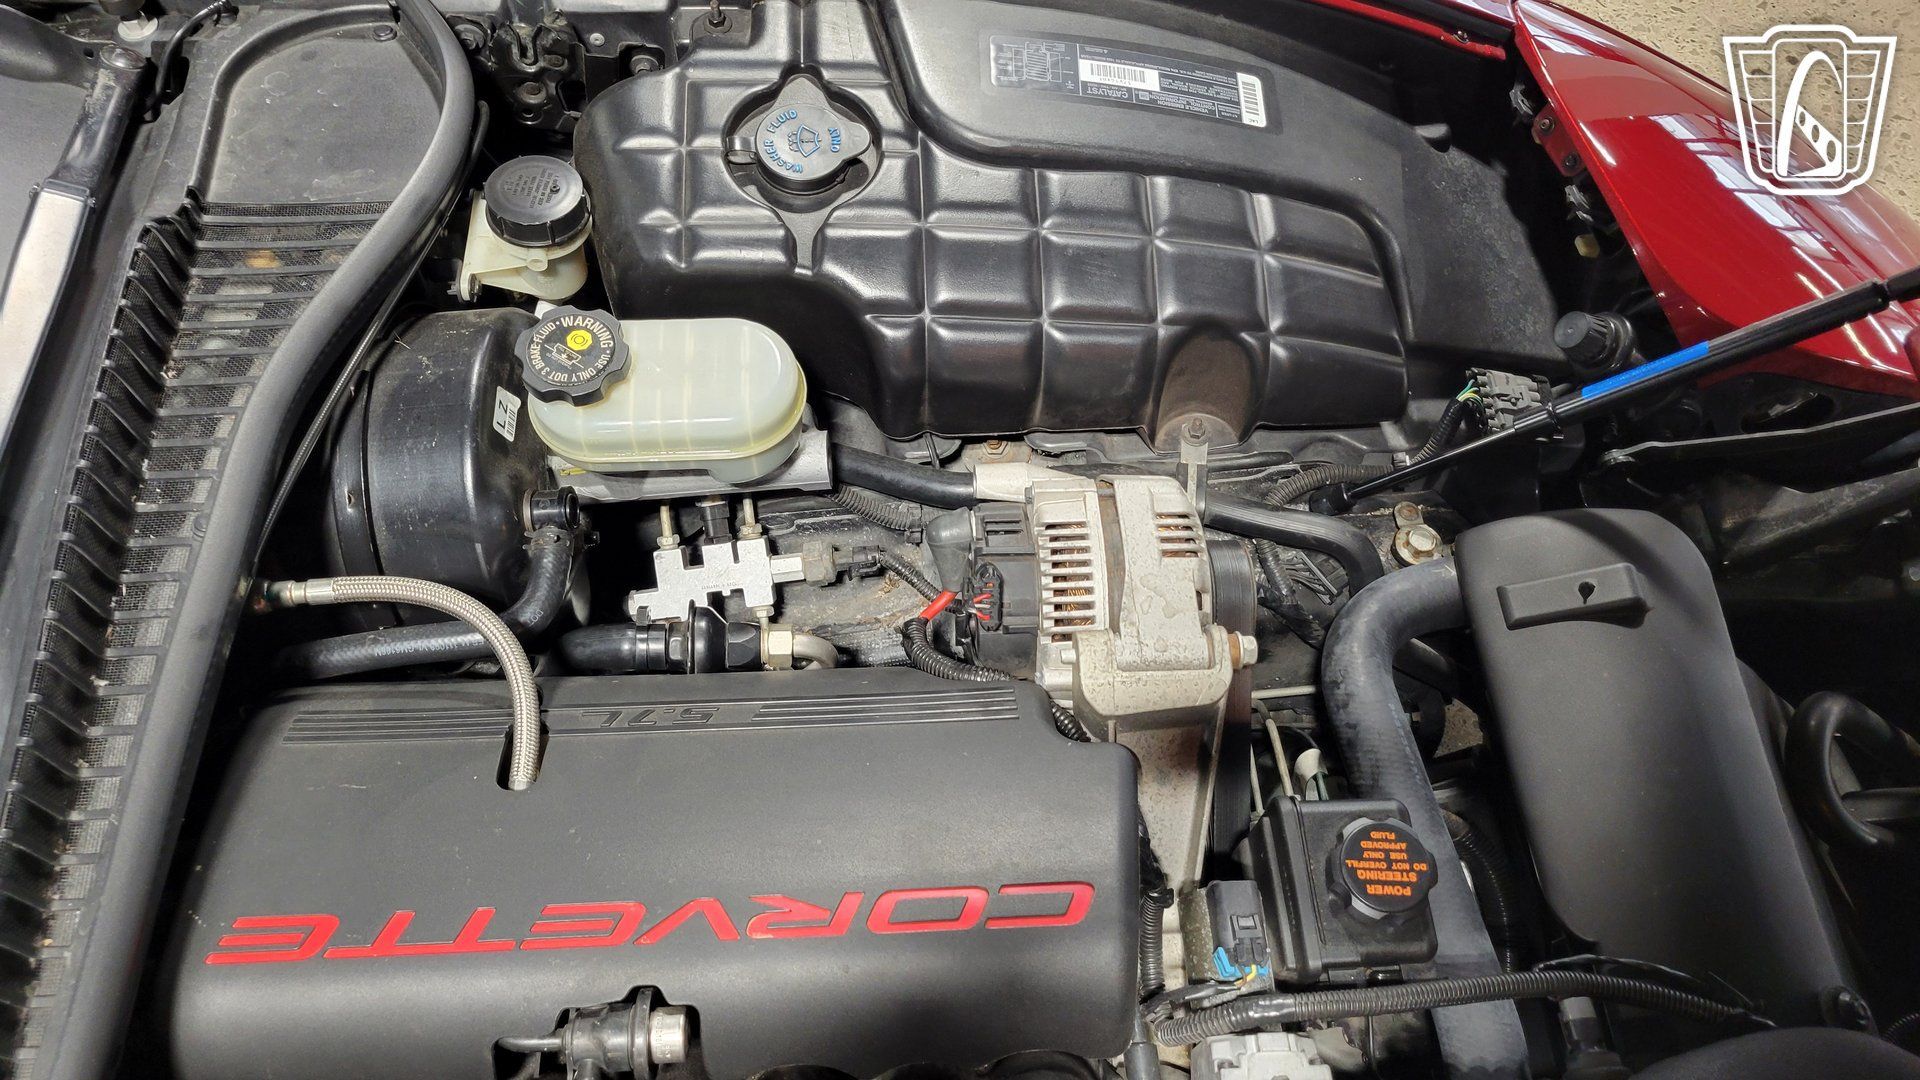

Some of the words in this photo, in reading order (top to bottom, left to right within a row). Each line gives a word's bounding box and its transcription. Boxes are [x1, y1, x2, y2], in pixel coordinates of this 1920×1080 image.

[1087, 86, 1128, 98] CATALYST
[1157, 100, 1185, 109] EMISSION
[767, 109, 798, 133] FLUID
[828, 127, 841, 153] ONLY
[763, 140, 803, 173] WASHER
[533, 322, 556, 343] FLUID
[561, 316, 613, 348] WARNING
[529, 343, 545, 370] BRAKE
[594, 354, 611, 369] USE
[541, 367, 550, 375] 3
[548, 371, 568, 382] DOT
[571, 367, 597, 382] ONLY
[582, 707, 720, 728] 5.7L
[1369, 831, 1396, 840] FLUID
[1360, 841, 1408, 850] APPROVED
[1362, 851, 1385, 859] ONLY
[1389, 852, 1408, 860] USE
[1345, 859, 1387, 869] OVERFILL
[1391, 862, 1410, 870] NOT
[1413, 863, 1427, 871] DO
[1356, 869, 1417, 882] STEERING
[1366, 884, 1412, 896] POWER
[205, 880, 1095, 964] CORVETTE
